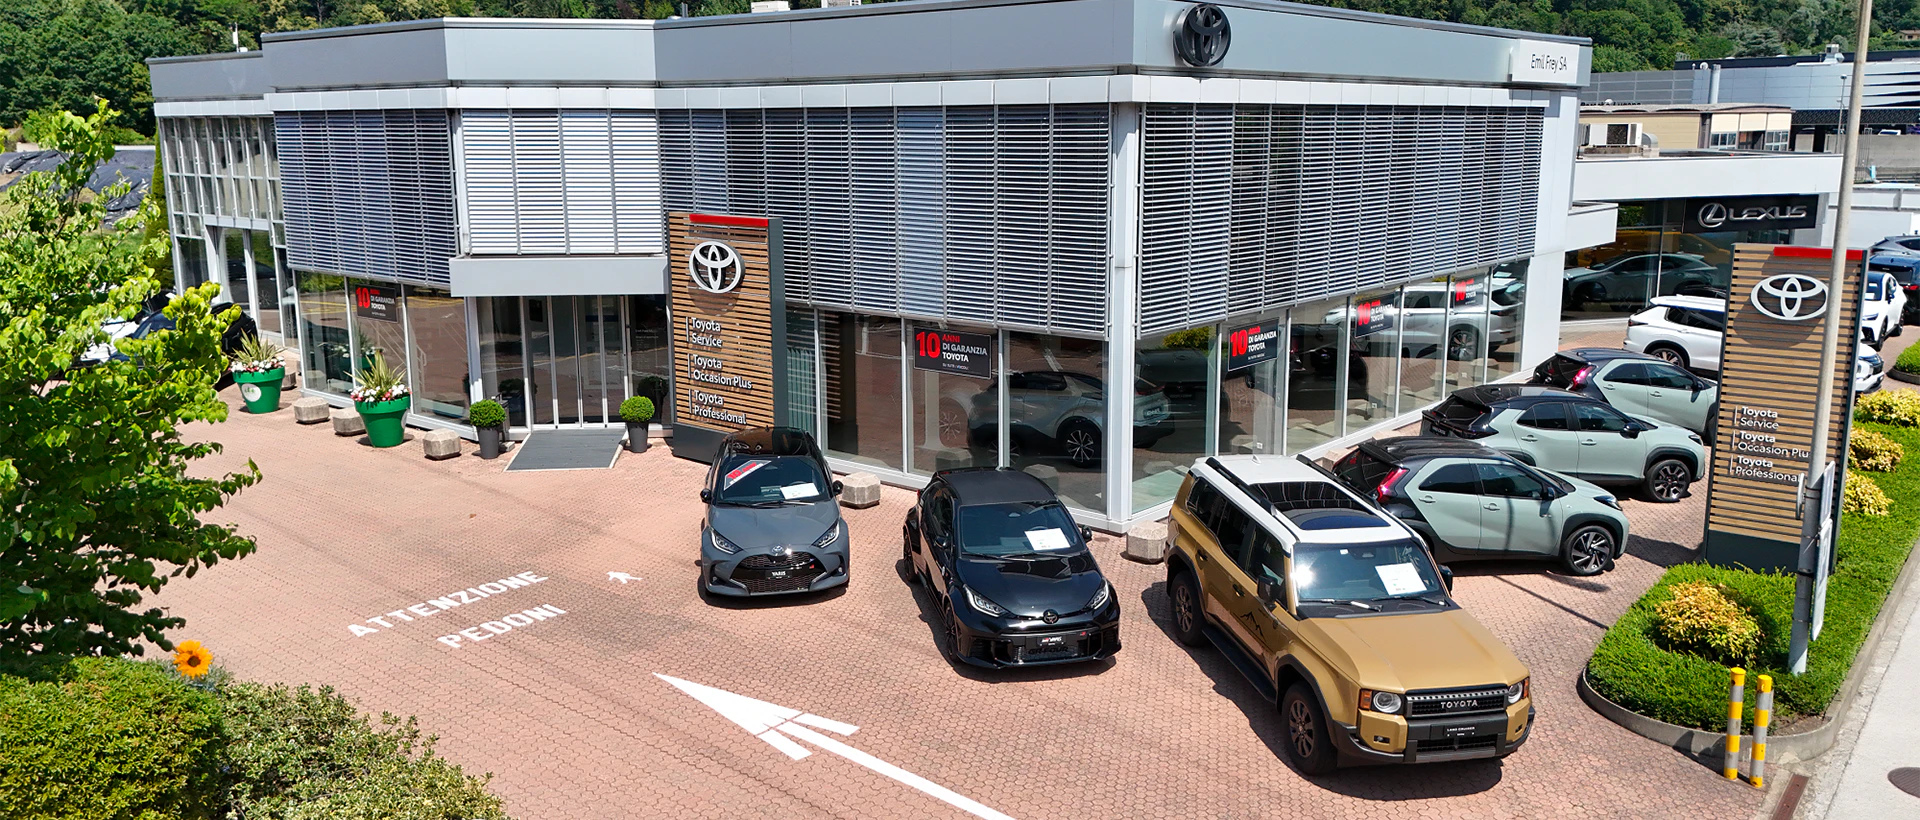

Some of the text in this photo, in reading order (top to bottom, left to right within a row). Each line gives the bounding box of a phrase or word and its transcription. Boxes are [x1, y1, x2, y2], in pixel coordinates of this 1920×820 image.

[1531, 53, 1567, 74] Emil Frey SA
[1729, 205, 1807, 220] LEXUS
[356, 287, 370, 308] 10
[1358, 302, 1371, 326] 10
[691, 317, 721, 332] Toyota
[691, 332, 722, 347] Service
[916, 331, 940, 358] 10
[942, 334, 960, 343] ANNI
[1231, 330, 1248, 357] 10
[1248, 331, 1277, 344] DI GARANZIA
[942, 343, 988, 356] DI GARANZIA
[1248, 342, 1265, 352] TOYOTA
[693, 354, 722, 369] Toyota
[942, 352, 969, 362] TOYOTA
[693, 369, 753, 389] Occasion Plus
[694, 390, 724, 405] Toyota
[694, 405, 747, 424] Professional
[1741, 406, 1778, 418] Toyota
[1740, 417, 1779, 430] Service
[1739, 430, 1776, 443] Toyota
[1737, 442, 1809, 458] Occasion Plu
[1737, 455, 1773, 468] Toyota
[347, 571, 549, 637] ATTENZIONE
[437, 603, 566, 648] PEDONI
[1440, 700, 1478, 709] TOYOTA
